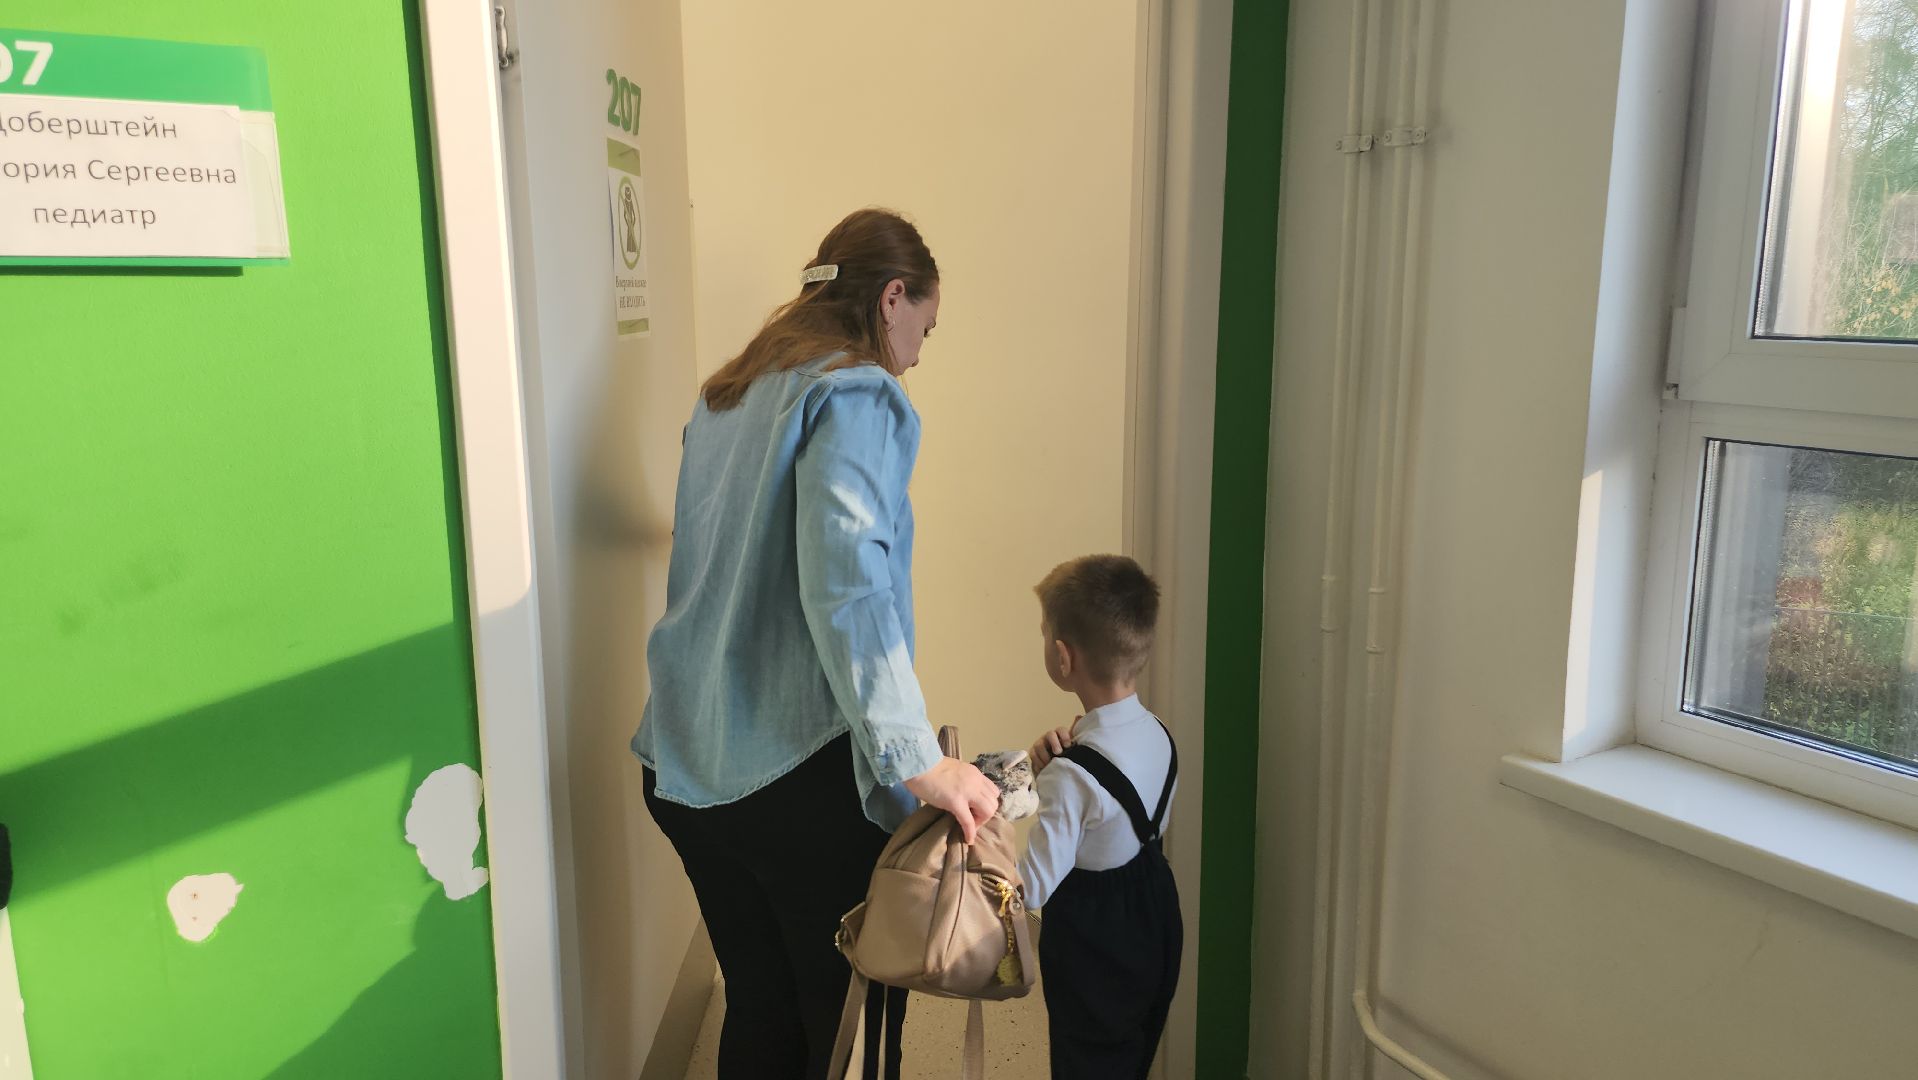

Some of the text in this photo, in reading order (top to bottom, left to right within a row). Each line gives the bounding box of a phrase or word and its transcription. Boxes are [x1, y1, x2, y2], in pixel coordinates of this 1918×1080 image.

[606, 68, 642, 136] 207
[87, 159, 237, 187] Сергеевна
[33, 207, 157, 230] педиатр
